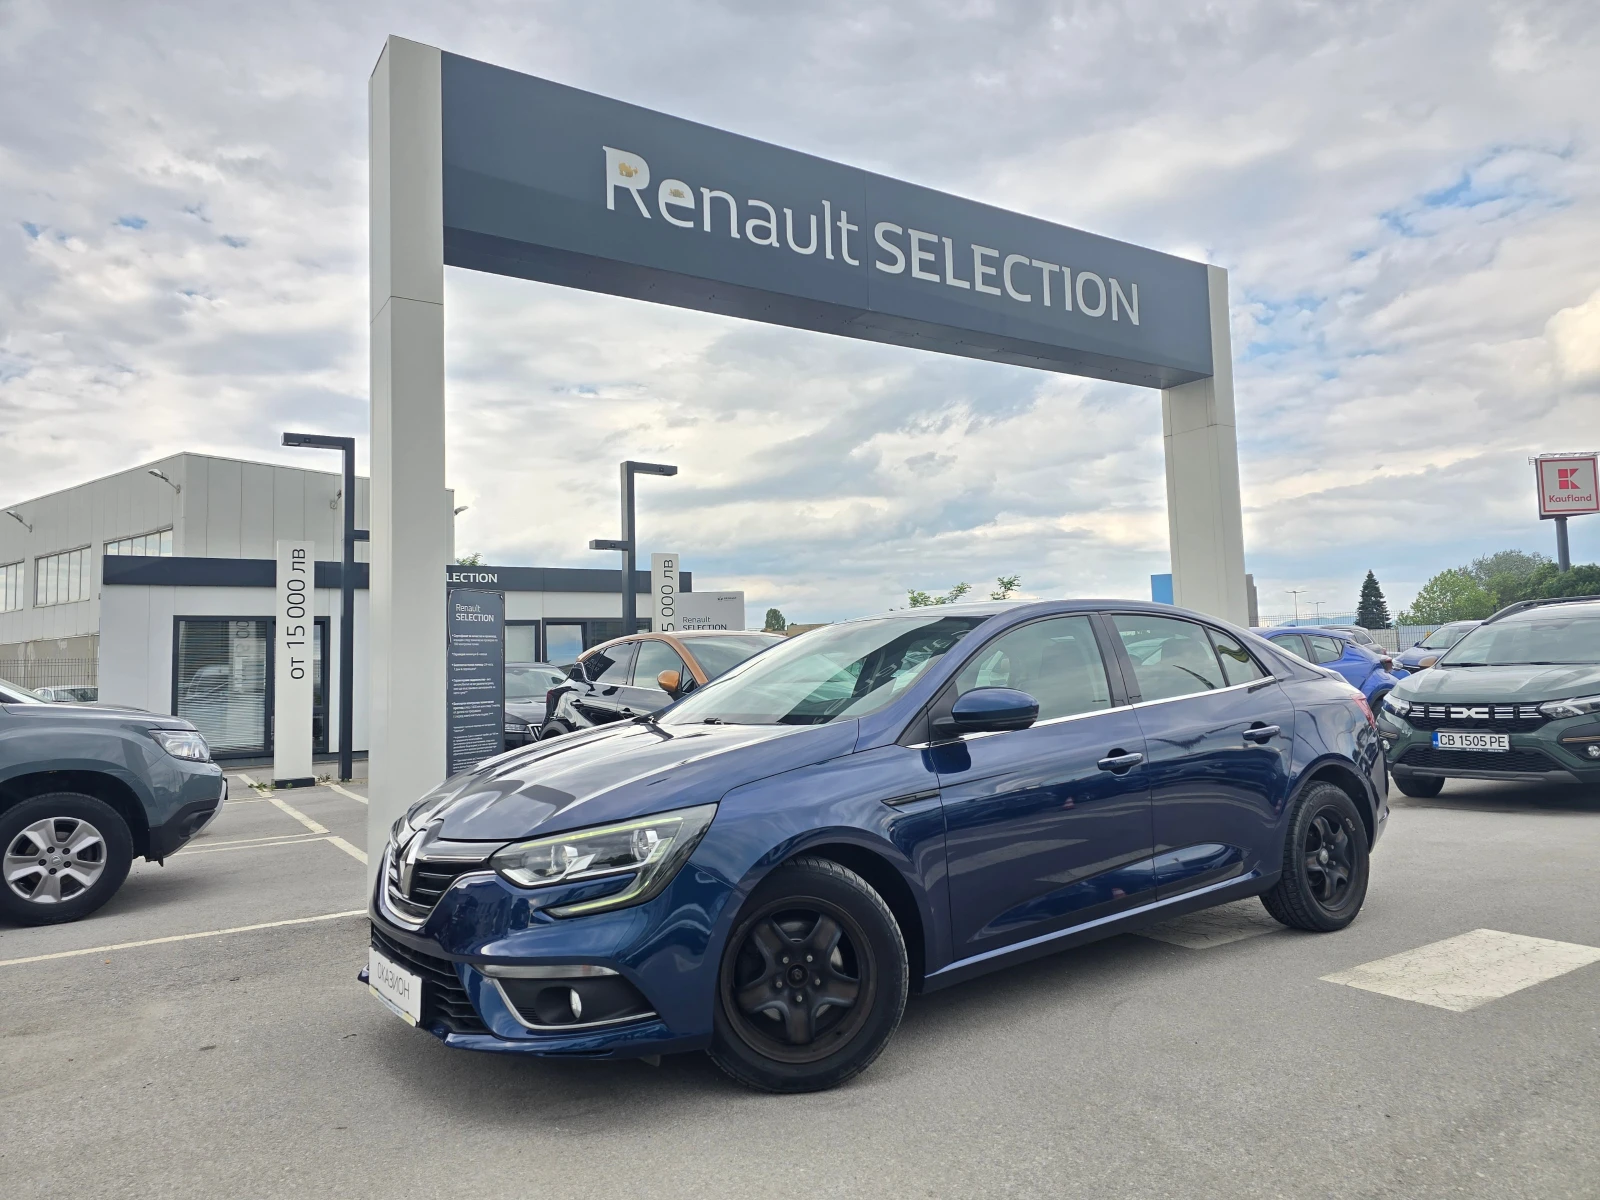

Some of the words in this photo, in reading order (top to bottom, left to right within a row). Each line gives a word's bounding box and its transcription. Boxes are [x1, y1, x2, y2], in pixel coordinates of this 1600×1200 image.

[602, 145, 860, 267] Renault
[874, 221, 1140, 326] SELECTION
[1548, 493, 1592, 503] Kaufland
[286, 579, 306, 619] 000
[660, 584, 675, 617] 000
[455, 613, 495, 622] SELECTION
[682, 616, 711, 624] Renault
[286, 625, 305, 649] 15
[1440, 734, 1456, 746] CB
[1458, 735, 1488, 747] 1505
[1489, 736, 1507, 748] PE
